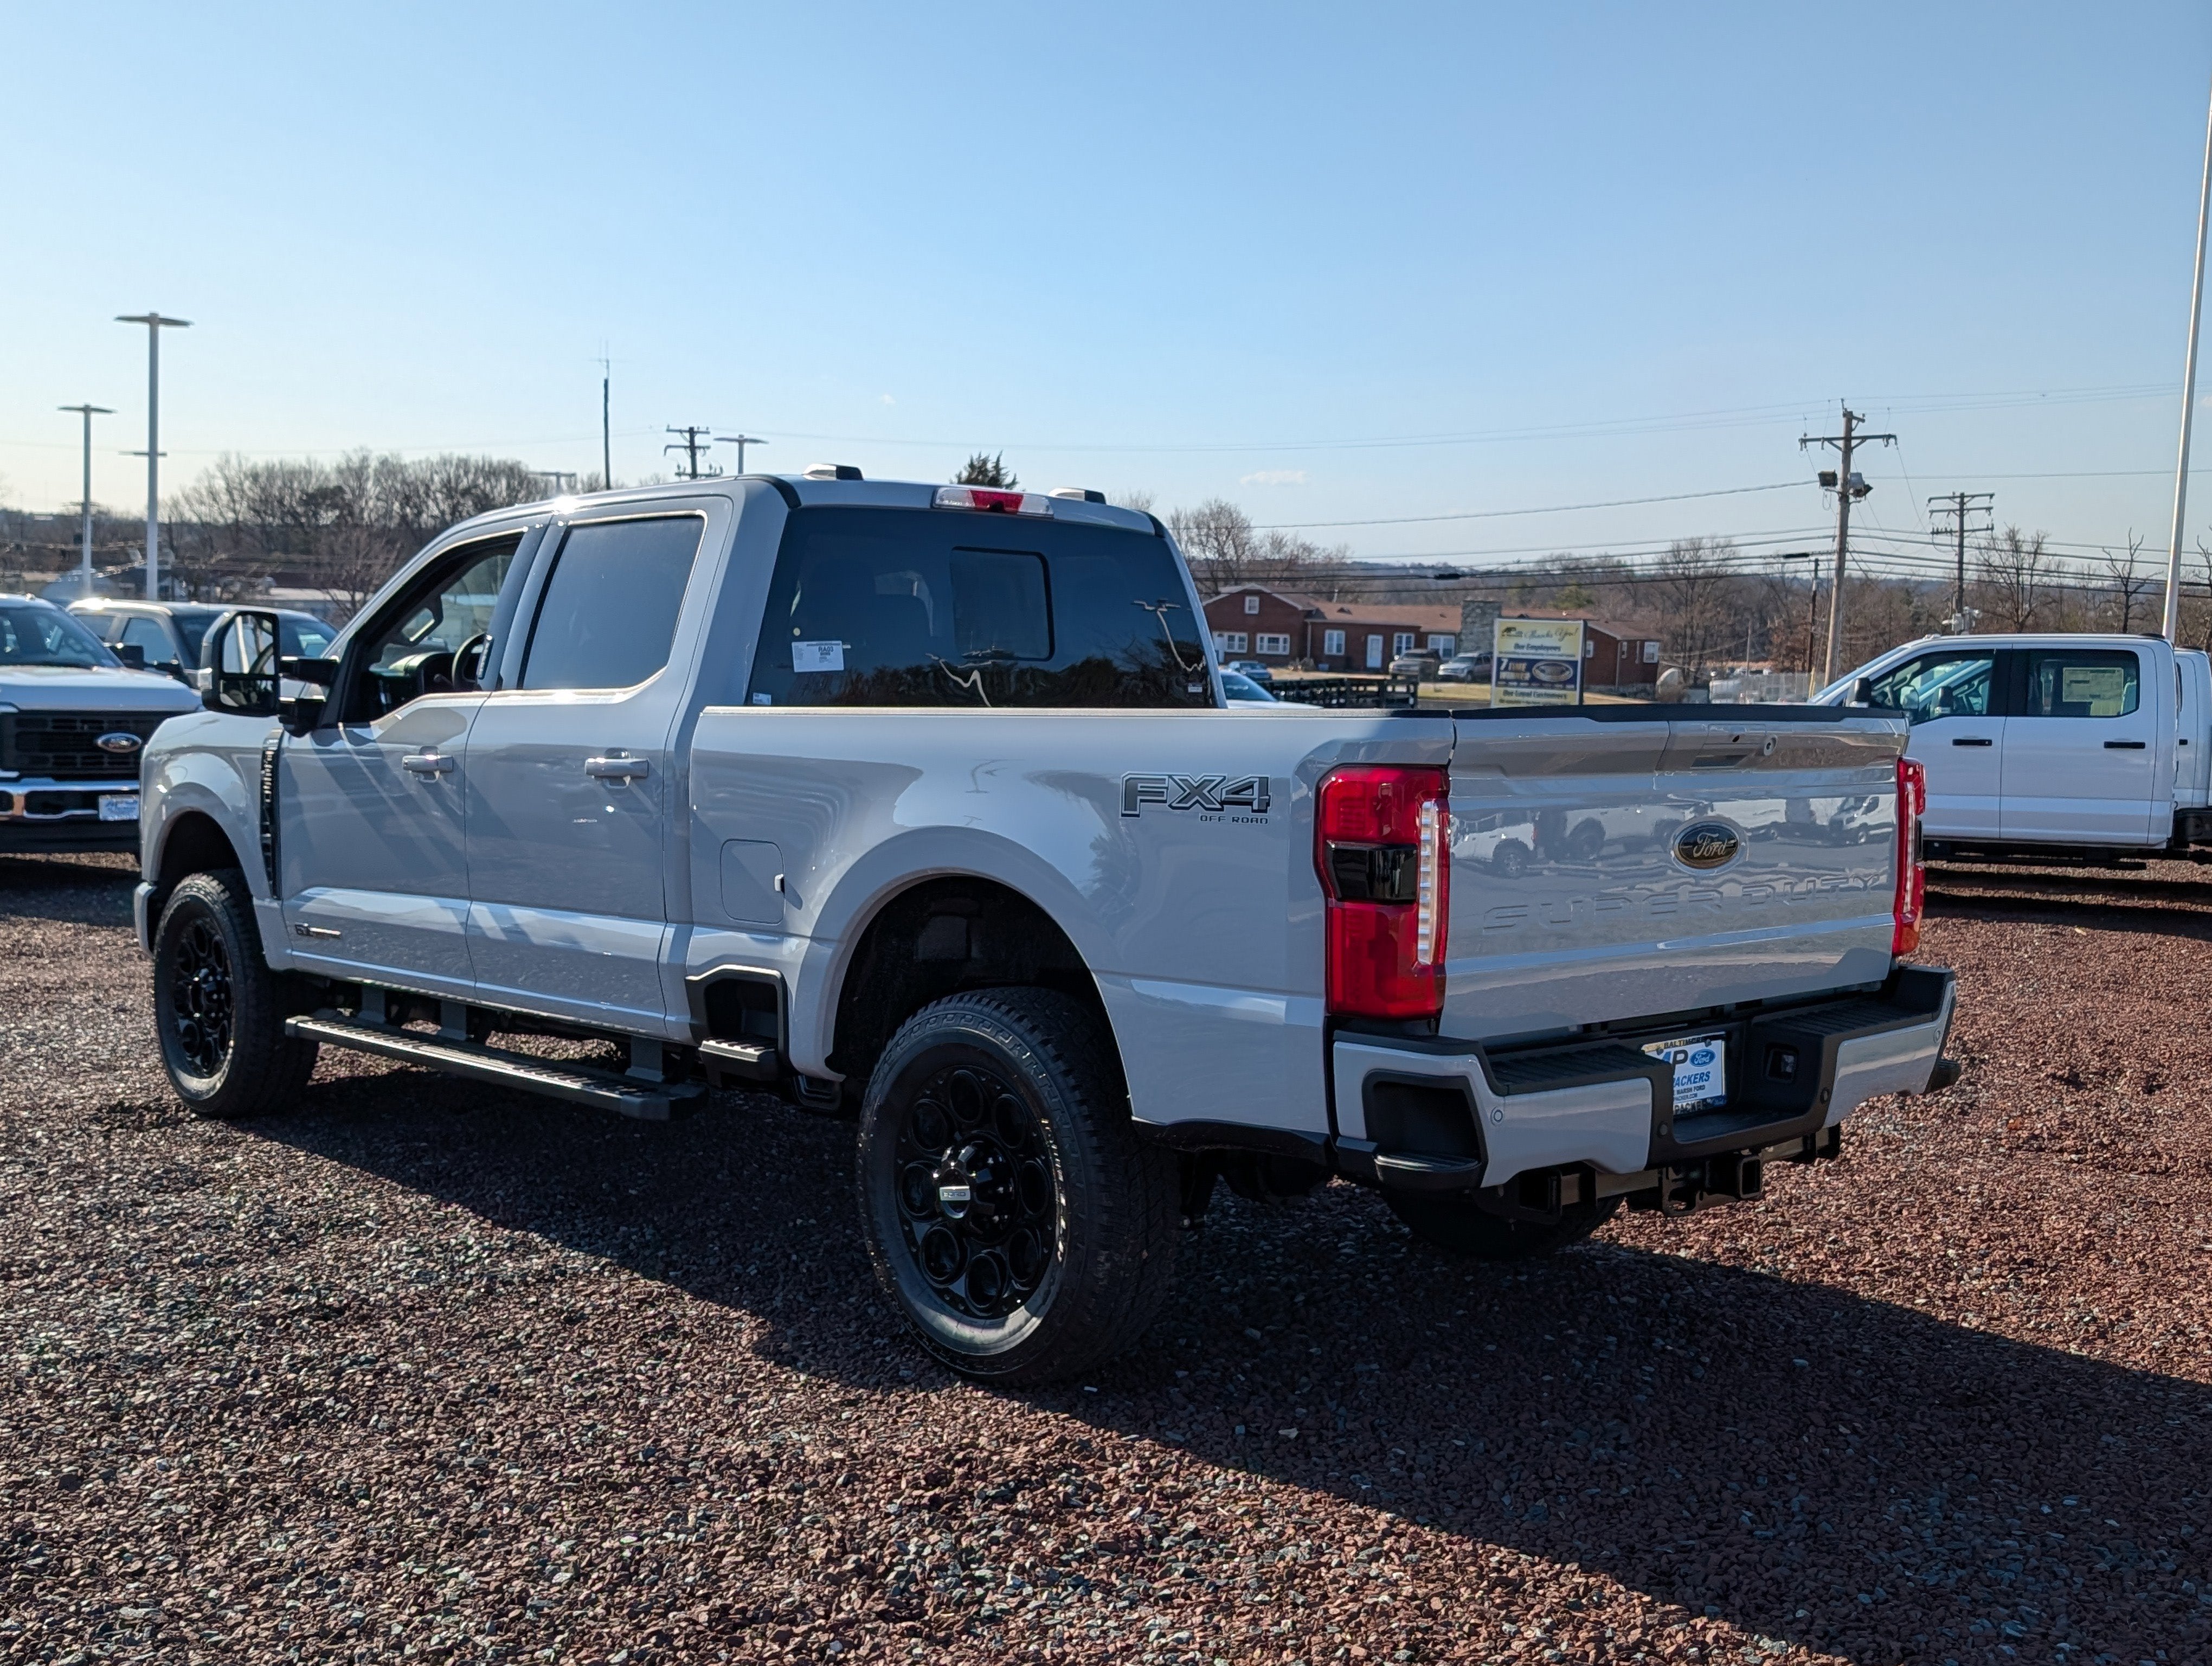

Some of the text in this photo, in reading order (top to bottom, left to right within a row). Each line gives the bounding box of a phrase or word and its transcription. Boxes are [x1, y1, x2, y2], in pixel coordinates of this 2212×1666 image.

[1121, 771, 1271, 818] FX4
[1232, 816, 1269, 824] ROAD
[1693, 832, 1728, 858] Ford
[1483, 888, 1723, 933] SUPER
